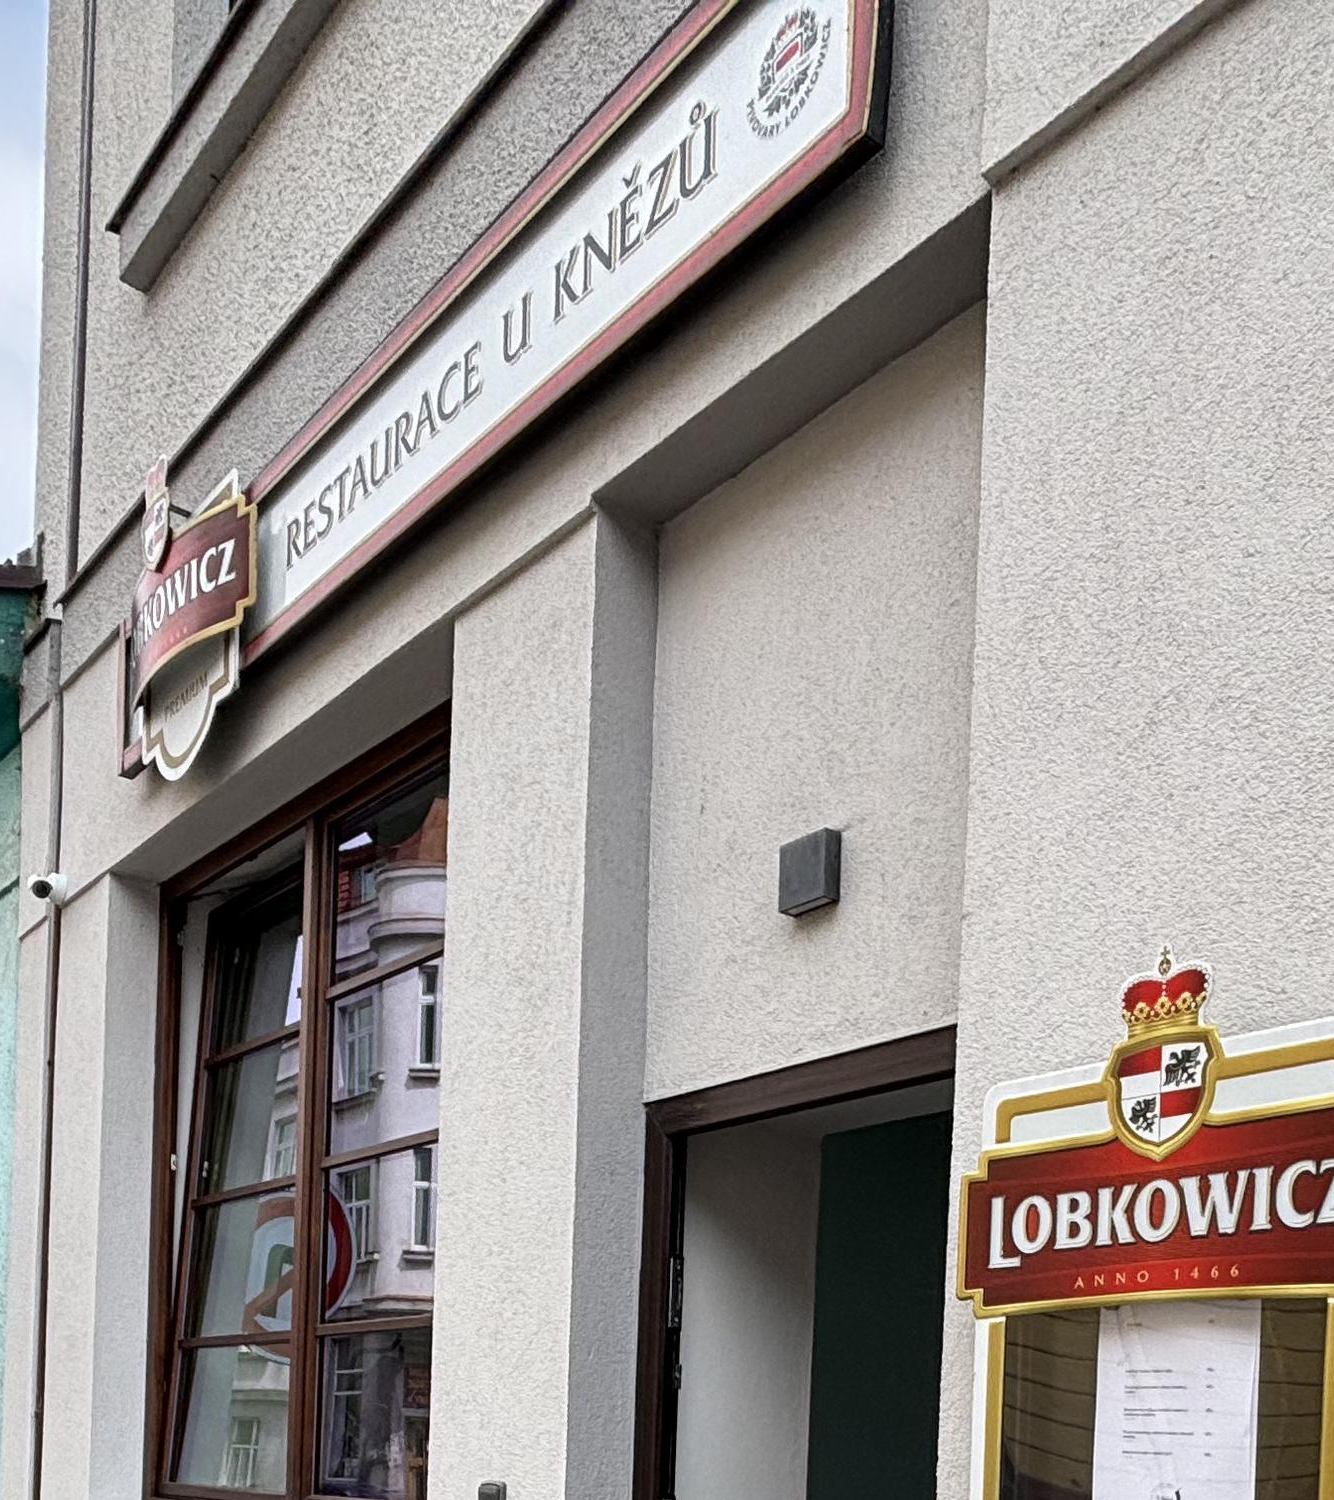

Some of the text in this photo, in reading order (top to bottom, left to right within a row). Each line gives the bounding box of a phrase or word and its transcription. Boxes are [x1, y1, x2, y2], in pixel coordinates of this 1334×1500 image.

[285, 102, 719, 569] RESTAURACE U KNĚZŮ
[1073, 1263, 1241, 1290] ANNO 1466
